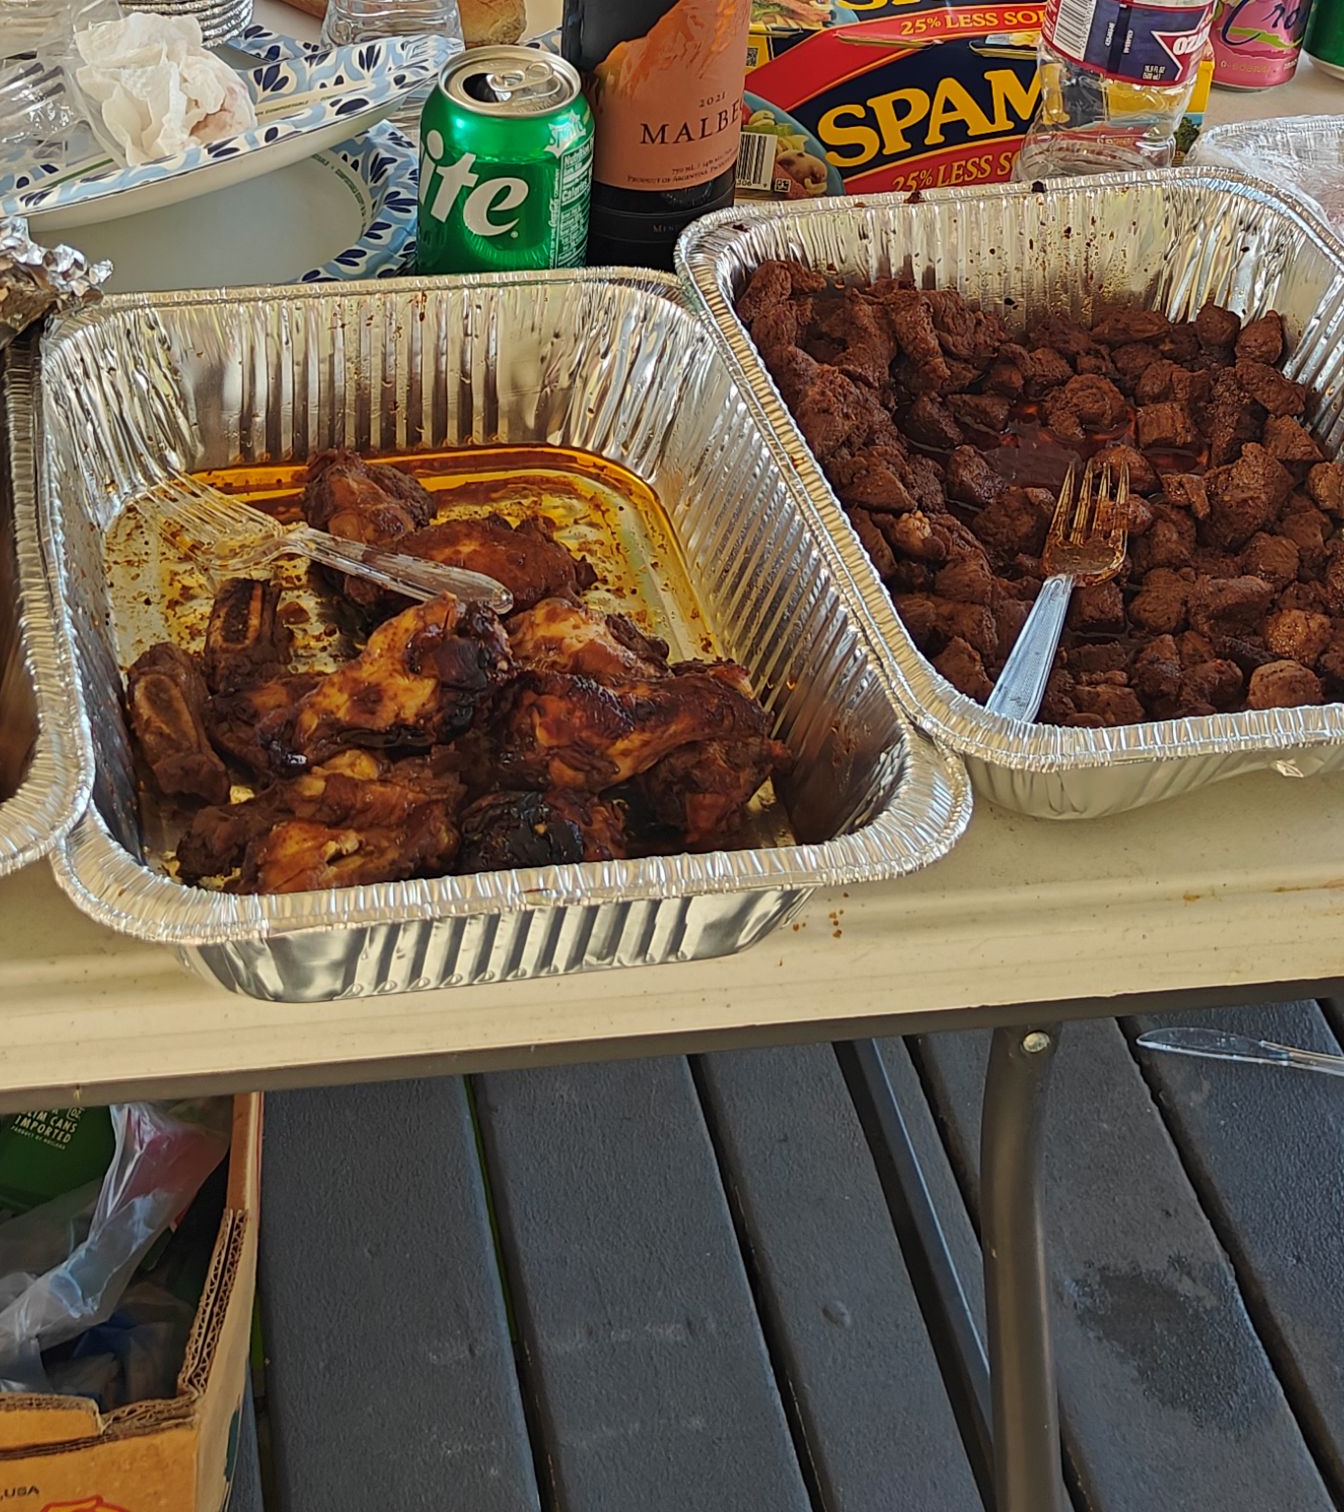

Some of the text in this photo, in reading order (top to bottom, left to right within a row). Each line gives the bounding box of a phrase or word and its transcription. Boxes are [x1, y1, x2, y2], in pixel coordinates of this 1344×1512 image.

[900, 16, 942, 36] 25%
[945, 10, 1000, 30] LESS
[699, 91, 726, 107] 2021
[640, 97, 742, 144] MALBE
[817, 69, 1046, 168] SPAM
[420, 129, 529, 236] ite
[937, 155, 992, 187] LESS
[15, 1114, 72, 1143] IMPORTED
[50, 1116, 77, 1133] CANS
